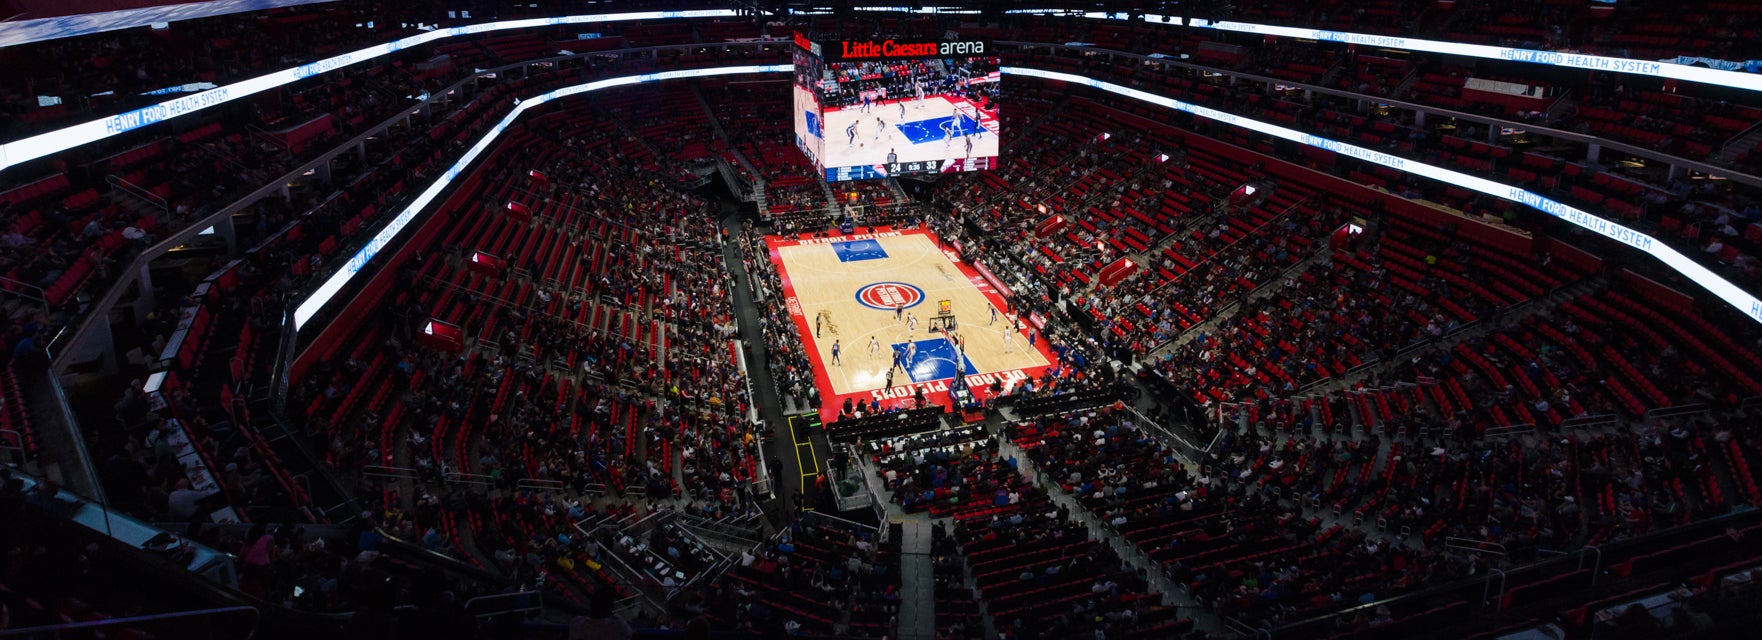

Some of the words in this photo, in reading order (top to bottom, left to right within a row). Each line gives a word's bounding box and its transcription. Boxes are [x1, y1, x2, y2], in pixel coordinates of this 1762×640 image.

[842, 41, 881, 58] Little
[883, 40, 937, 57] Caesars
[940, 41, 984, 55] arena
[1312, 30, 1331, 41] HENRY
[1332, 32, 1350, 42] FORD
[1352, 34, 1376, 46] HEALTH
[1378, 37, 1405, 48] SYSTEM
[1500, 48, 1533, 61] HENRY
[1535, 51, 1564, 65] FORD
[1567, 54, 1609, 69] HEALTH
[1612, 59, 1660, 75] SYSTEM
[105, 111, 141, 134] HENRY
[142, 104, 168, 124] FORD
[169, 96, 200, 116] HEALTH
[201, 88, 229, 107] SYSTEM
[890, 163, 901, 173] 24
[926, 160, 937, 170] 33
[1300, 133, 1323, 147] HENRY
[1323, 139, 1343, 152] FORD
[1343, 145, 1371, 160] HEALTH
[1373, 152, 1405, 169] SYSTEM
[1510, 188, 1542, 207] HENRY
[1543, 199, 1568, 218] FORD
[1570, 208, 1608, 232] HEALTH
[1610, 223, 1652, 252] SYSTEM
[347, 251, 366, 277] HENRY
[365, 238, 380, 260] FORD
[396, 208, 411, 230] SYSTEM
